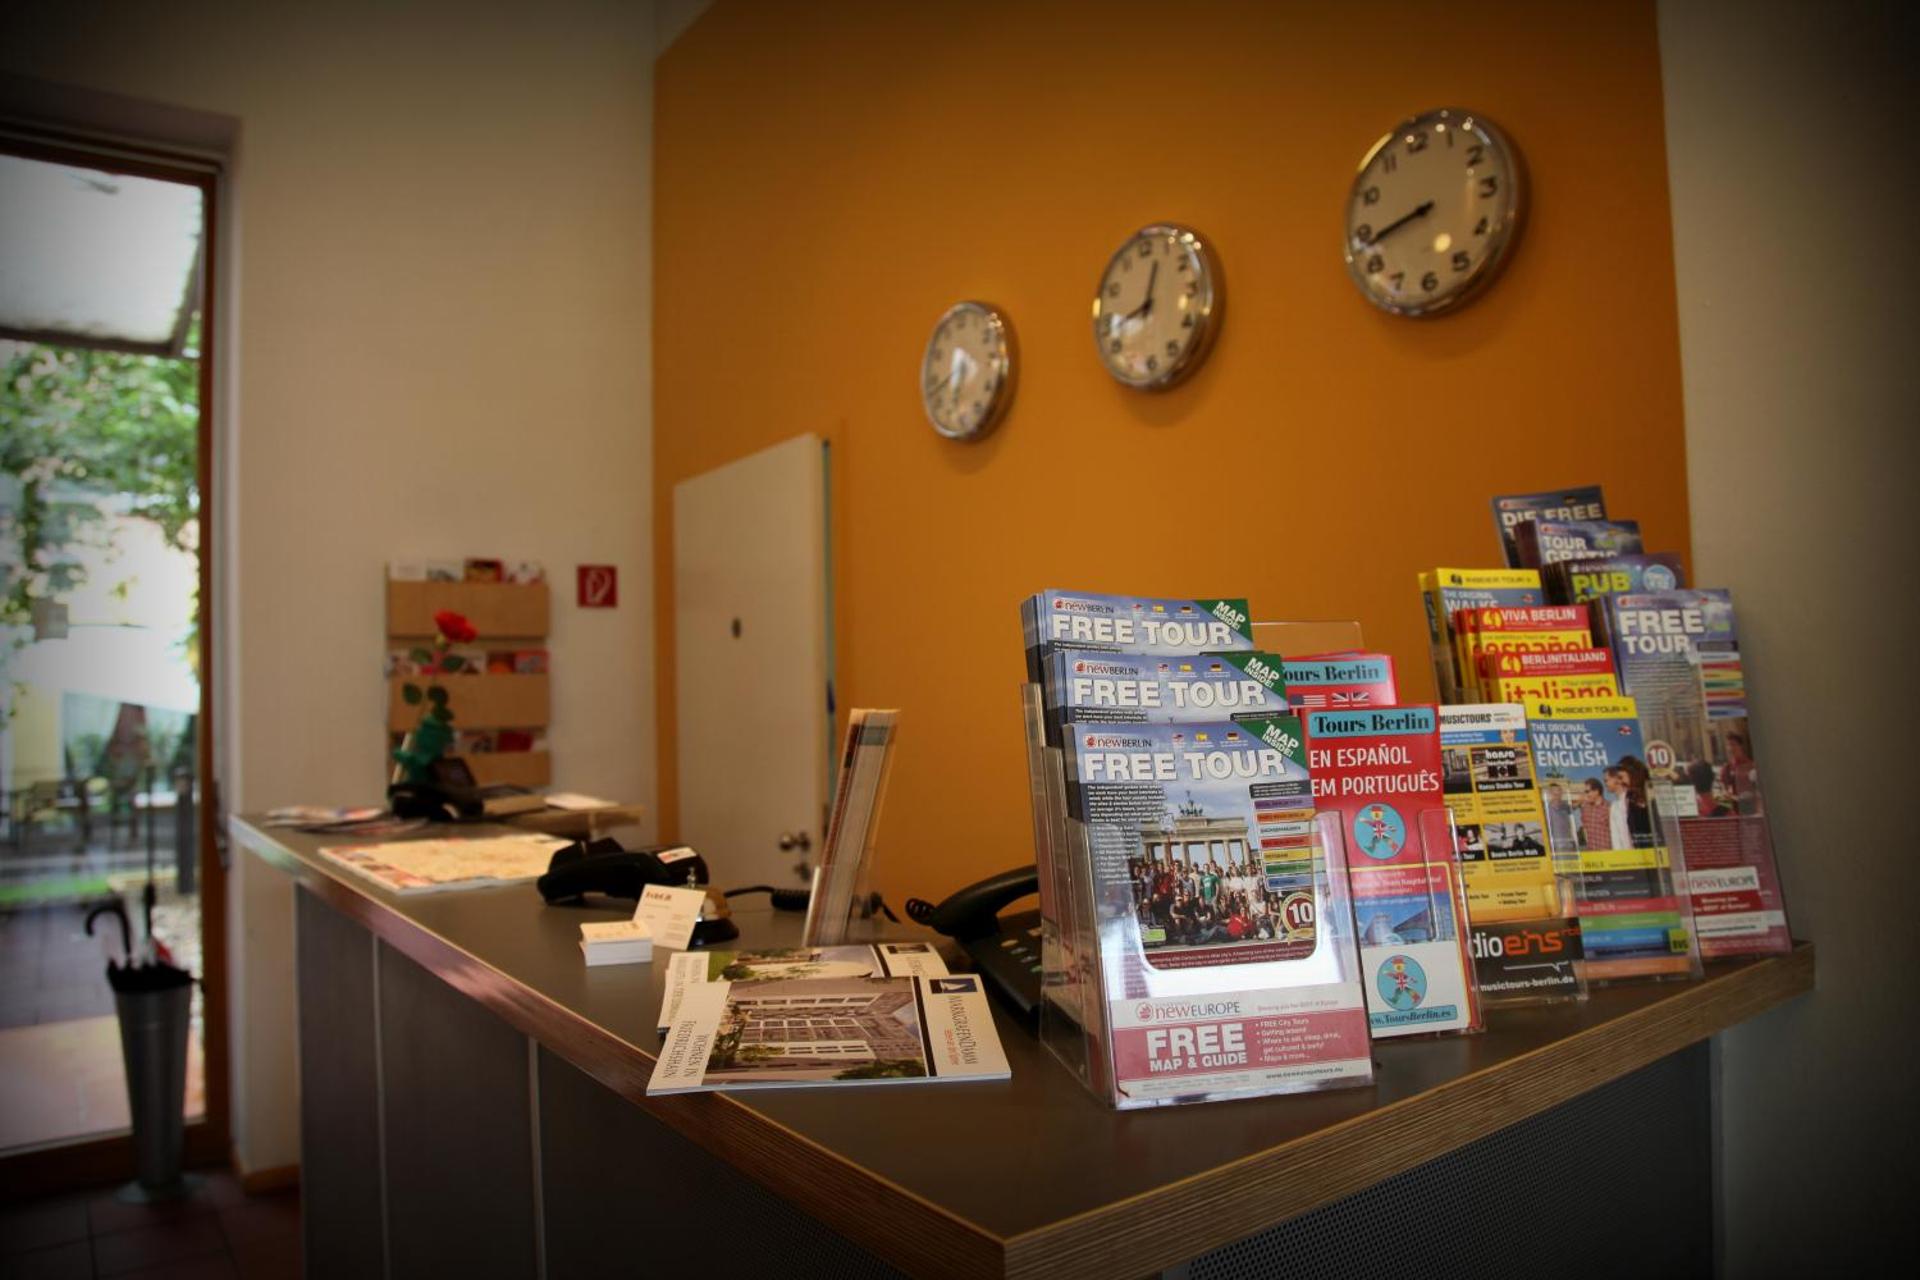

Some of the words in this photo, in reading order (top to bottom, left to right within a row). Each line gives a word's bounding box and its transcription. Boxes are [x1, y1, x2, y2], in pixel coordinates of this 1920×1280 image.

[1383, 154, 1398, 174] 11
[1467, 145, 1484, 167] 2
[1363, 186, 1380, 205] 10
[1480, 176, 1498, 198] 3
[1475, 217, 1489, 236] 4
[1367, 255, 1384, 273] 8
[1453, 252, 1470, 271] 5
[1391, 272, 1405, 291] 7
[1422, 272, 1438, 291] 6
[1182, 315, 1194, 328] 4
[1167, 339, 1179, 357] 5
[1147, 356, 1158, 371] 6
[1544, 503, 1604, 521] FREE
[1543, 535, 1588, 550] TOUR
[1571, 571, 1633, 595] PUB
[1212, 609, 1241, 631] INSIDE!
[1216, 600, 1247, 624] MAP
[1501, 609, 1529, 622] VIVA
[1531, 608, 1577, 622] BERLIN
[1619, 608, 1705, 635] FREE
[1052, 614, 1136, 644] FREE
[1141, 620, 1234, 647] TOUR
[1622, 635, 1691, 655] TOUR
[1520, 651, 1607, 666] BERLINITALIANO
[1086, 664, 1139, 676] newBERLIN
[1242, 666, 1275, 690] INSIDE!
[1246, 657, 1281, 682] MAP
[1283, 668, 1321, 682] ours
[1325, 664, 1380, 682] Berlin
[1072, 678, 1162, 708] FREE
[1168, 679, 1267, 709] TOUR
[1315, 715, 1367, 734] Tours
[1371, 712, 1430, 732] Berlin
[1531, 723, 1545, 733] THE
[1547, 722, 1588, 733] ORIGINAL
[1097, 737, 1152, 749] newBERLIN
[1261, 733, 1294, 758] INSIDE!
[1265, 723, 1300, 749] MAP
[1532, 732, 1595, 750] WALKS
[1084, 752, 1178, 781] FREE
[1183, 748, 1287, 780] TOUR
[1310, 750, 1331, 769] EN
[1337, 743, 1412, 768] ESPAÑOL
[1536, 750, 1609, 768] ENGLISH
[1649, 748, 1669, 766] 10
[1311, 778, 1336, 797] EM
[1342, 768, 1440, 797] PORTUGUÊS
[1288, 902, 1314, 925] 10
[1155, 1001, 1241, 1019] newEUROPE
[1146, 1023, 1246, 1060] FREE
[1149, 1058, 1183, 1073] MAP
[1187, 1056, 1198, 1069] &
[1202, 1052, 1249, 1067] GUIDE
